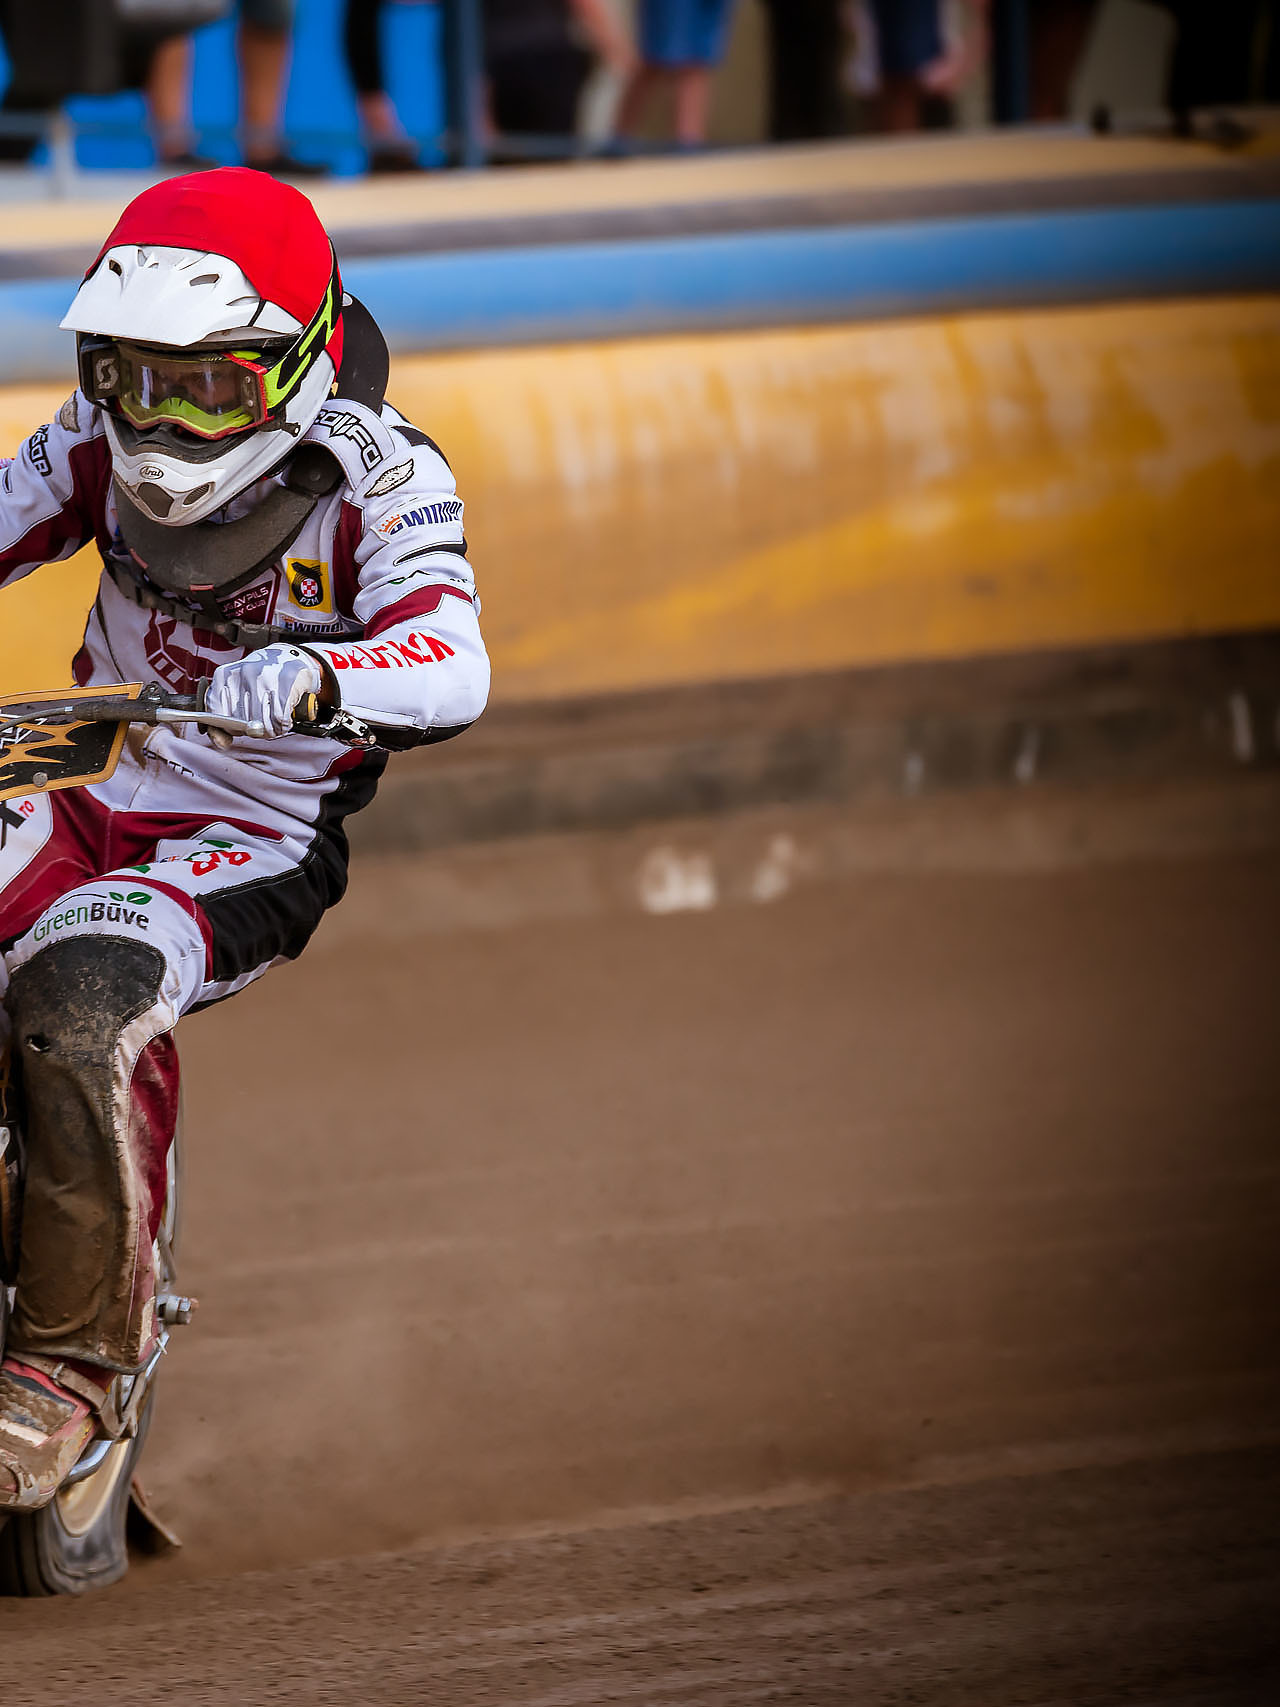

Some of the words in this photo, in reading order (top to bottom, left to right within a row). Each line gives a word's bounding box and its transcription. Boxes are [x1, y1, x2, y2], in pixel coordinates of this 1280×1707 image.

[141, 465, 162, 478] Arai
[299, 596, 320, 606] PZM
[33, 902, 150, 942] GreenBūve
